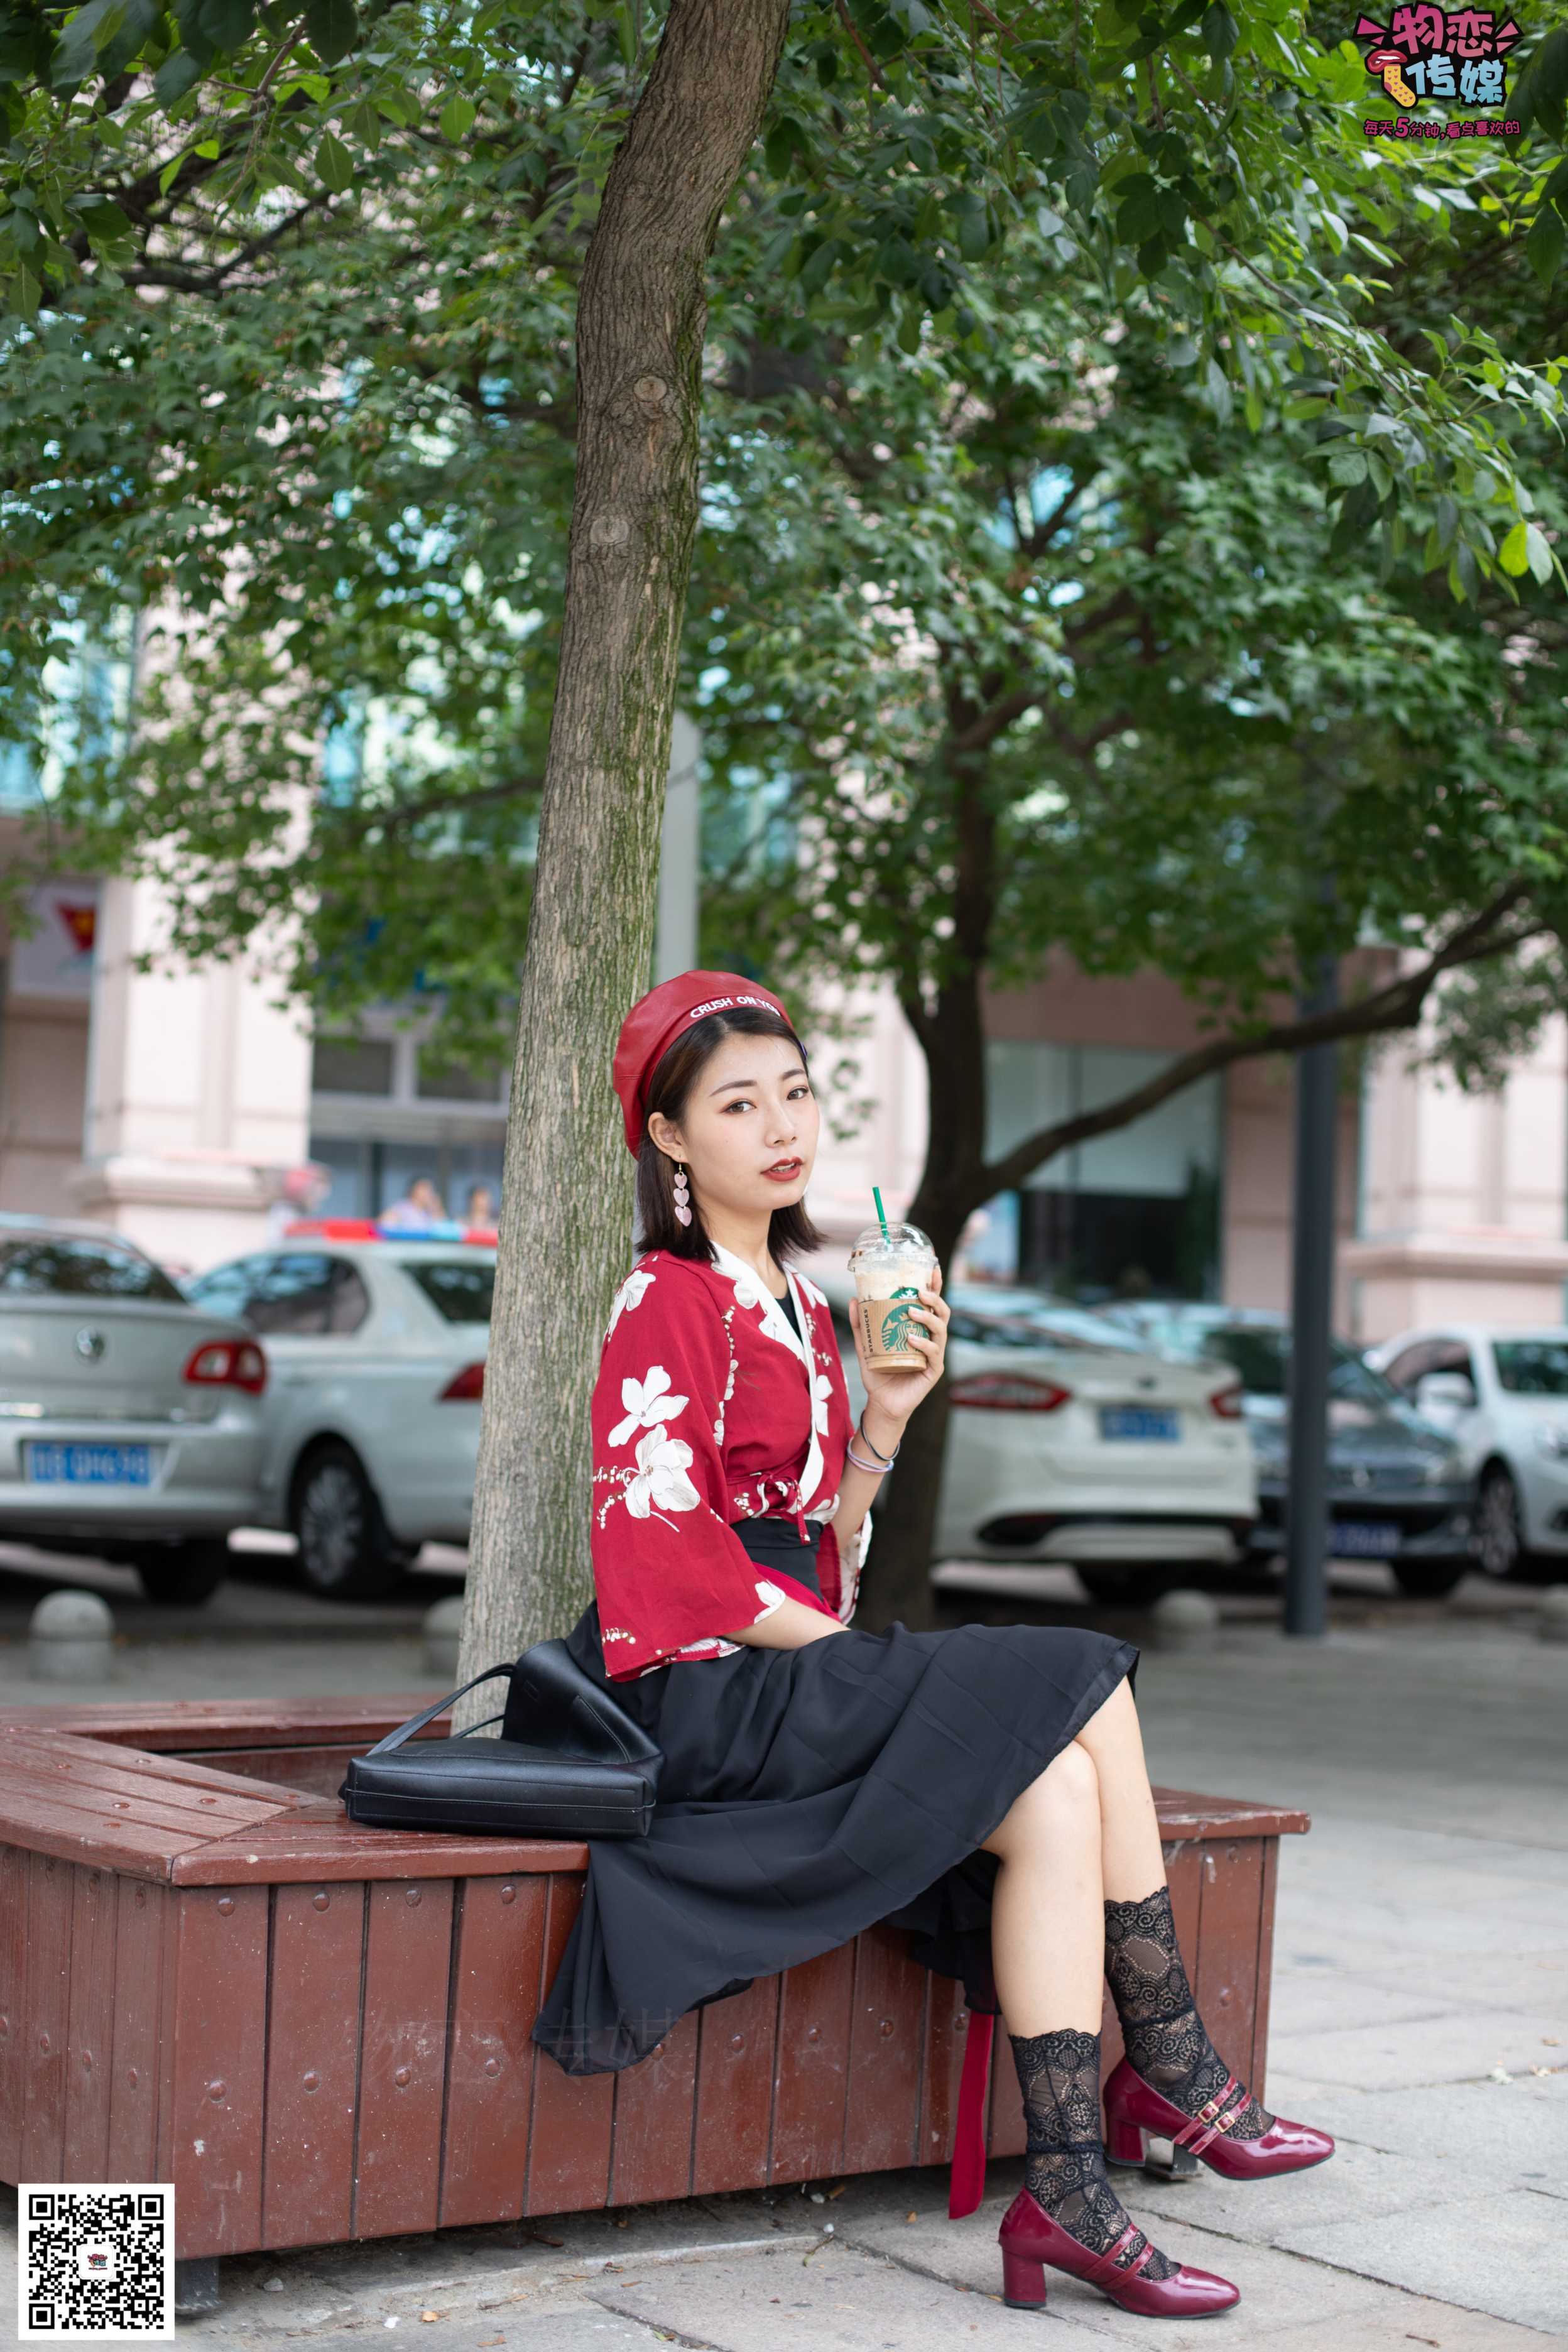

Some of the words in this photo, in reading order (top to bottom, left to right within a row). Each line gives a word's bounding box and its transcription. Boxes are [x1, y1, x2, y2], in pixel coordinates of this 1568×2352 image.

[690, 997, 733, 1018] CRUSH
[736, 996, 757, 1005] ON
[864, 1309, 873, 1353] STARBUCKS
